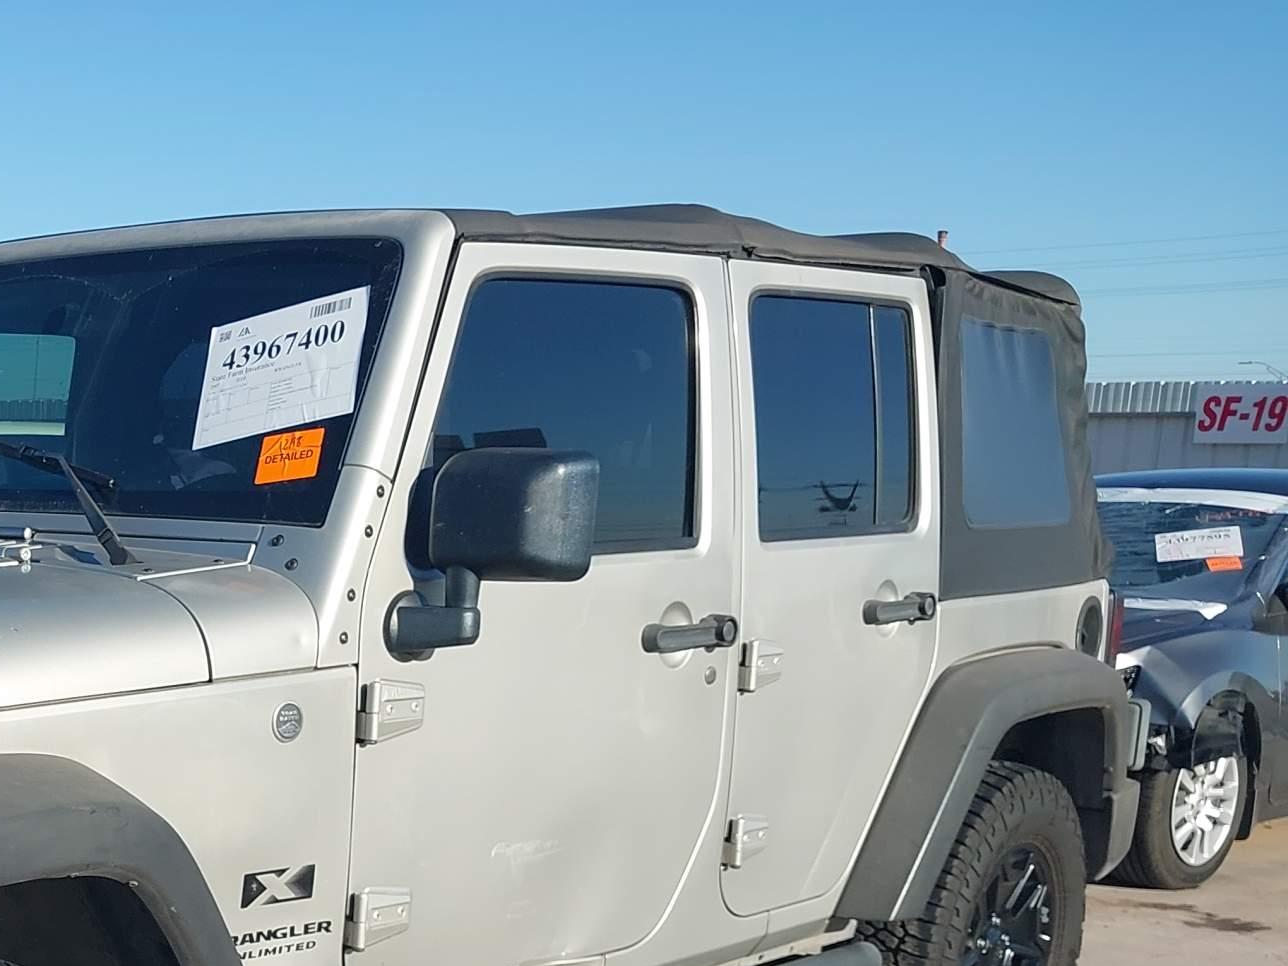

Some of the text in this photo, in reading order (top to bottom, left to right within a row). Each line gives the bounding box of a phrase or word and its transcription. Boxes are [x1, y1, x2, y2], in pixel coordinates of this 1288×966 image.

[222, 320, 345, 370] 43967400
[1197, 395, 1288, 432] SF-19
[264, 449, 314, 465] DETAILED
[231, 921, 332, 946] RANGLER
[240, 940, 316, 960] NLIMITED
